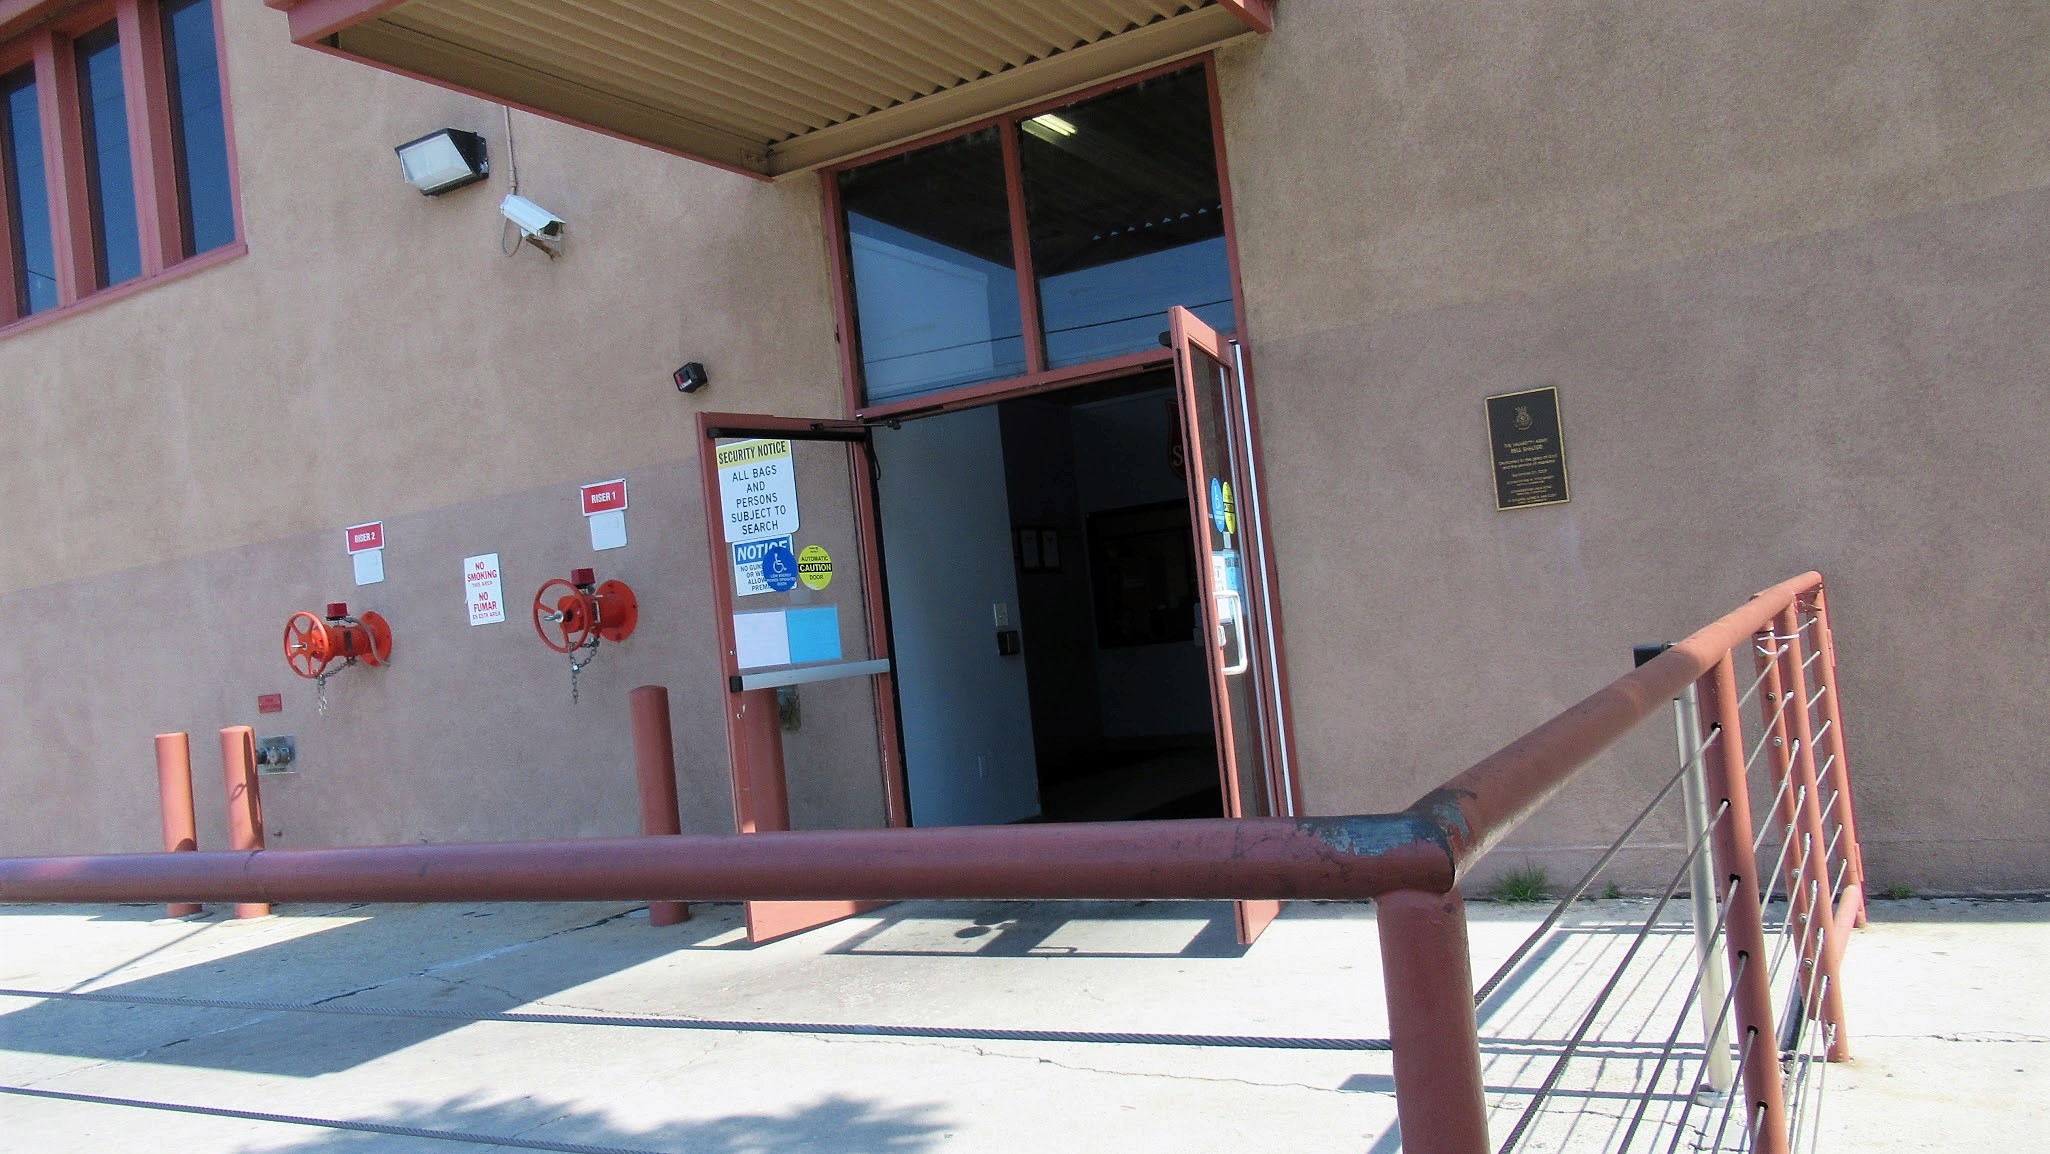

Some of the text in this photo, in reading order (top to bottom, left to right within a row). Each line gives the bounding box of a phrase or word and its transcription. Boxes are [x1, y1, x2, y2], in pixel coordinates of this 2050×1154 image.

[718, 441, 786, 464] SECURITY NOTICE
[732, 465, 777, 482] ALL BAGS
[747, 481, 765, 493] AND
[591, 491, 616, 503] RISER 1
[736, 493, 778, 508] PERSONS
[732, 505, 786, 522] SUBJECT TO
[742, 520, 779, 534] SEARCH
[355, 532, 375, 543] RISER 2
[475, 562, 484, 570] NO
[800, 563, 831, 572] CAUTION
[467, 570, 497, 582] SMOKING
[479, 592, 488, 601] NO
[474, 601, 497, 612] FUMAR
